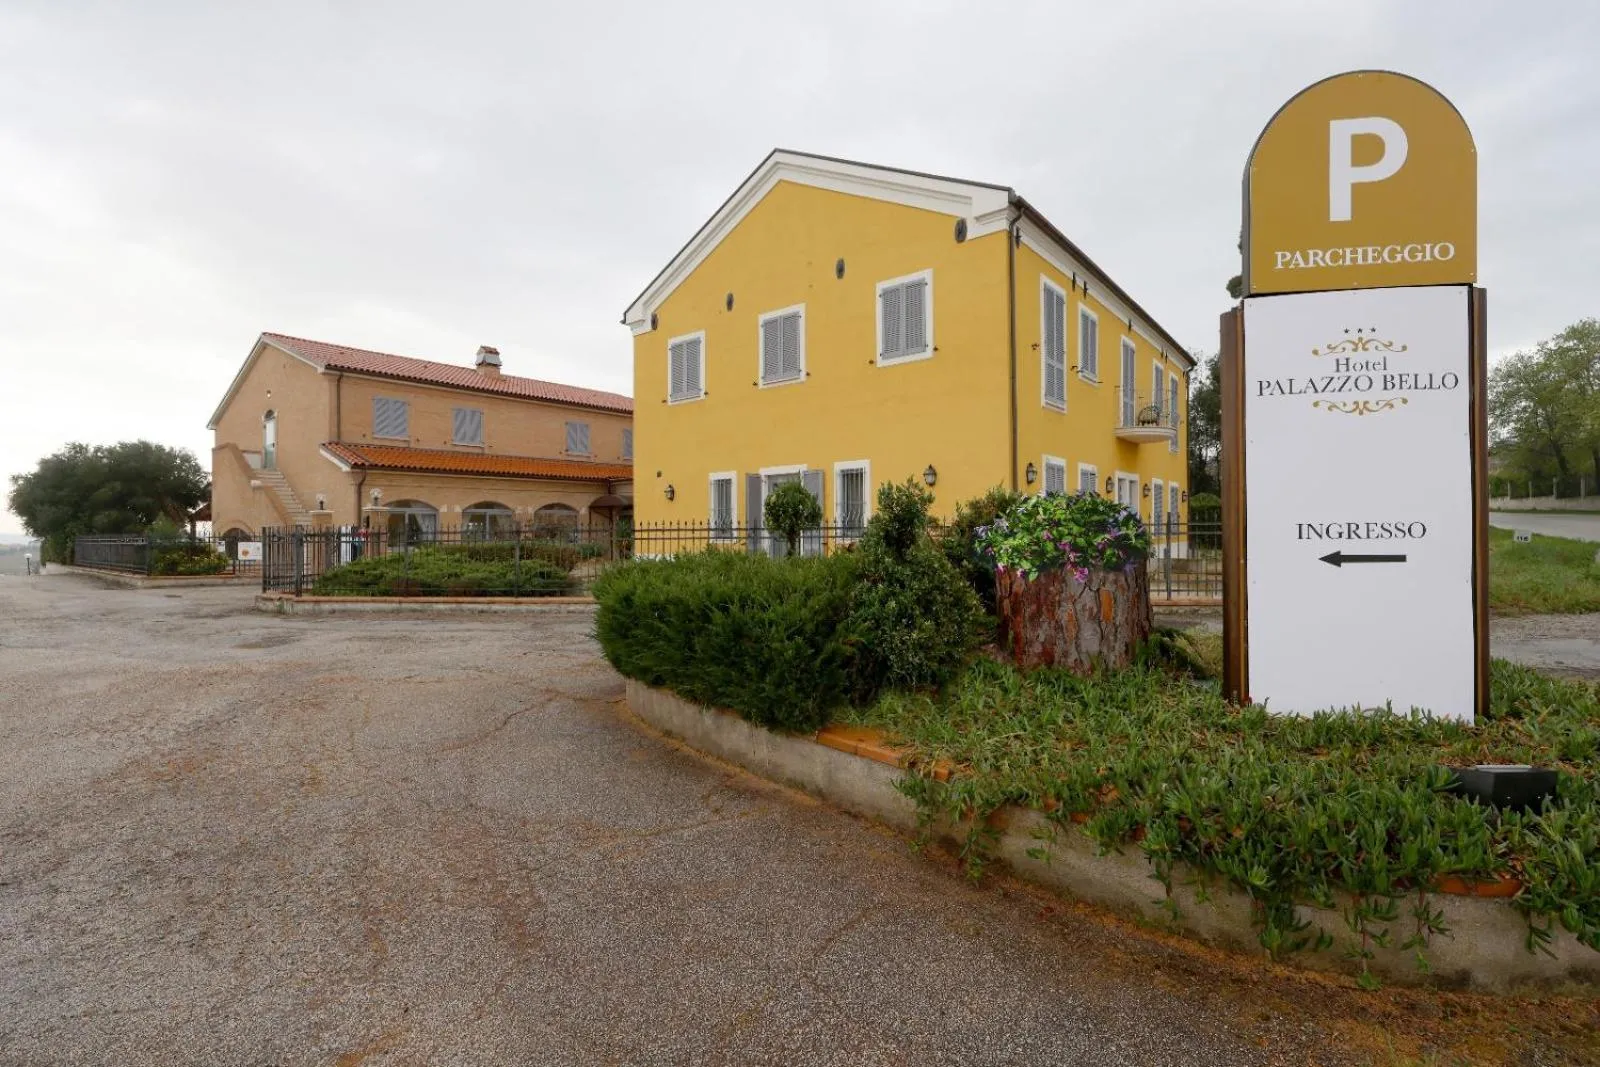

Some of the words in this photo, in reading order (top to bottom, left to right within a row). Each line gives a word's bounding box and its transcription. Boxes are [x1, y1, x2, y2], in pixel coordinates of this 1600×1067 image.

[1328, 116, 1409, 222] P
[1274, 242, 1456, 271] PARCHEGGIO
[1335, 356, 1389, 373] Hotel
[1257, 375, 1374, 397] PALAZZO
[1382, 372, 1460, 391] BELLO
[1296, 522, 1427, 541] INGRESSO
